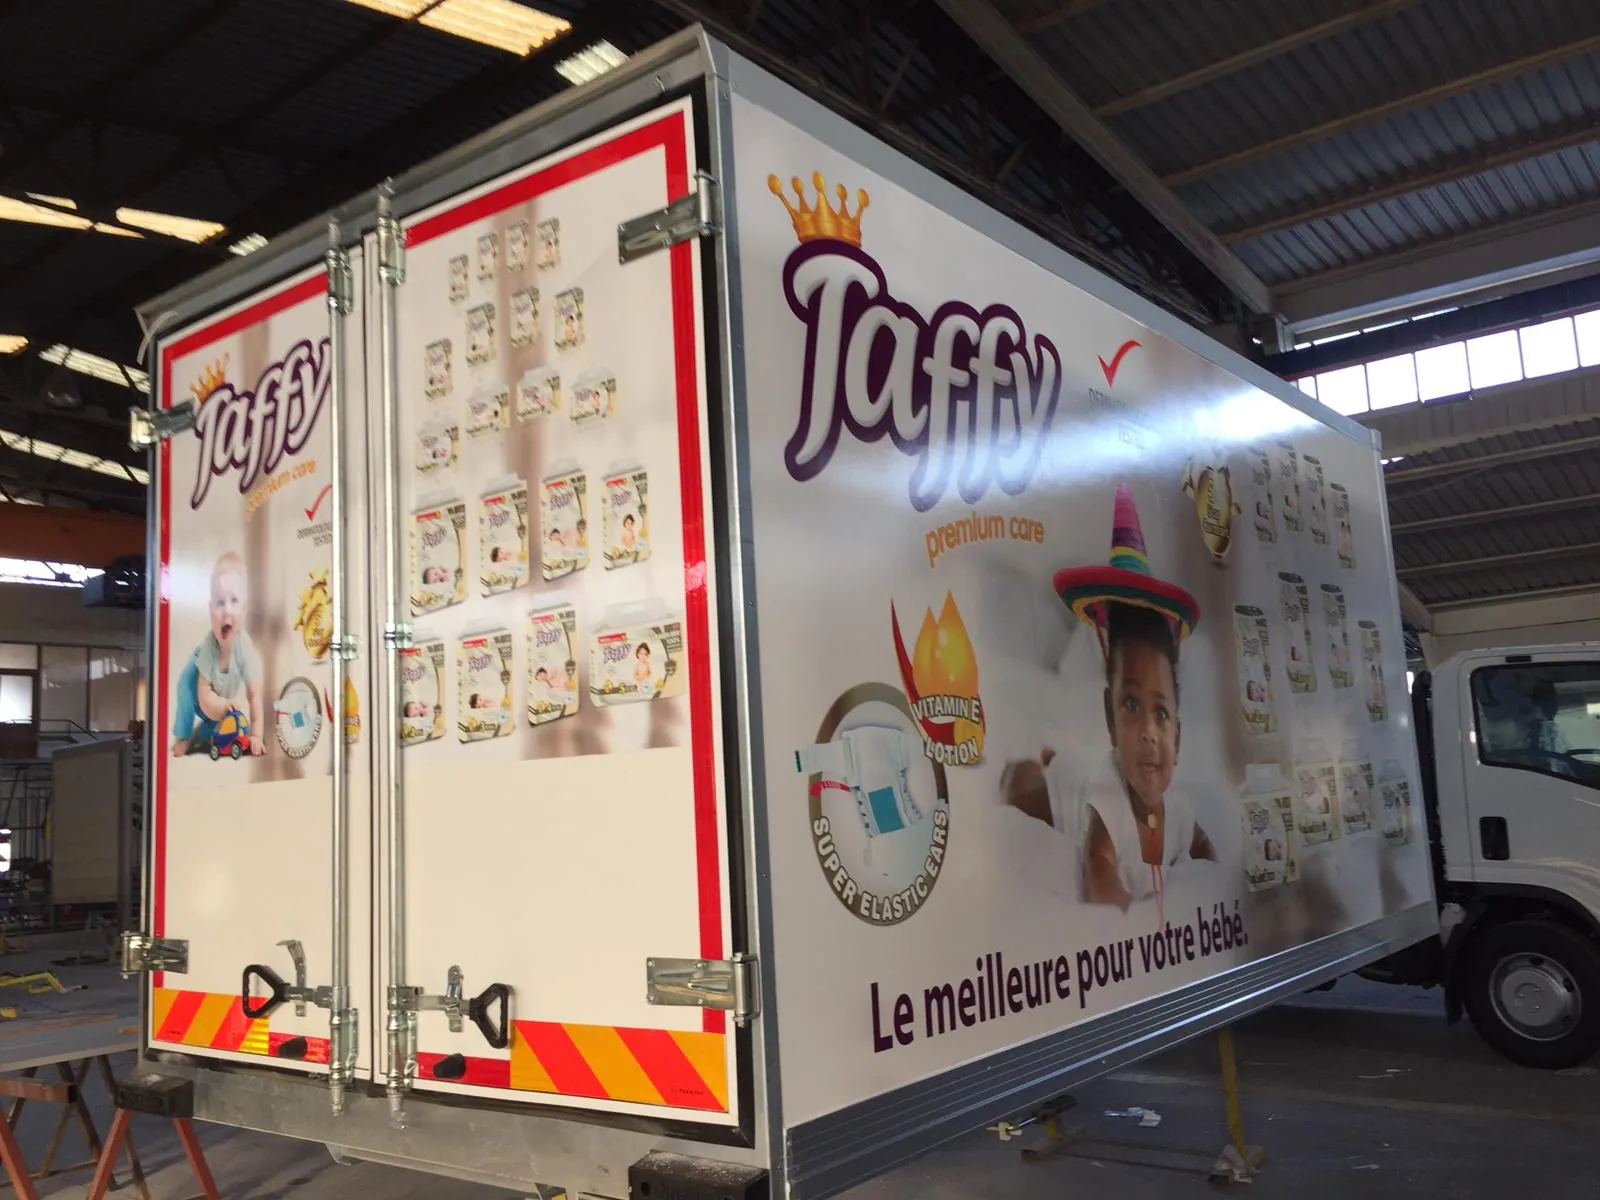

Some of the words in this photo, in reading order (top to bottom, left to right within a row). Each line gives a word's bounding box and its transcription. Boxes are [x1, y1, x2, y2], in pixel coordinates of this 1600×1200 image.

[190, 337, 334, 510] Taffy
[783, 239, 1062, 512] Taffy
[925, 510, 1005, 569] premium
[1009, 516, 1045, 545] care
[912, 694, 969, 721] VITAMIN
[970, 699, 981, 722] E
[923, 736, 979, 766] LOTION
[813, 815, 858, 906] SUPER
[859, 873, 929, 922] ELASTIC
[926, 809, 949, 880] EARS
[870, 981, 914, 1053] Le
[923, 951, 1070, 1038] meilleure
[1077, 938, 1134, 1008] pour
[1138, 922, 1195, 974] votre
[1197, 899, 1249, 957] bébé.
